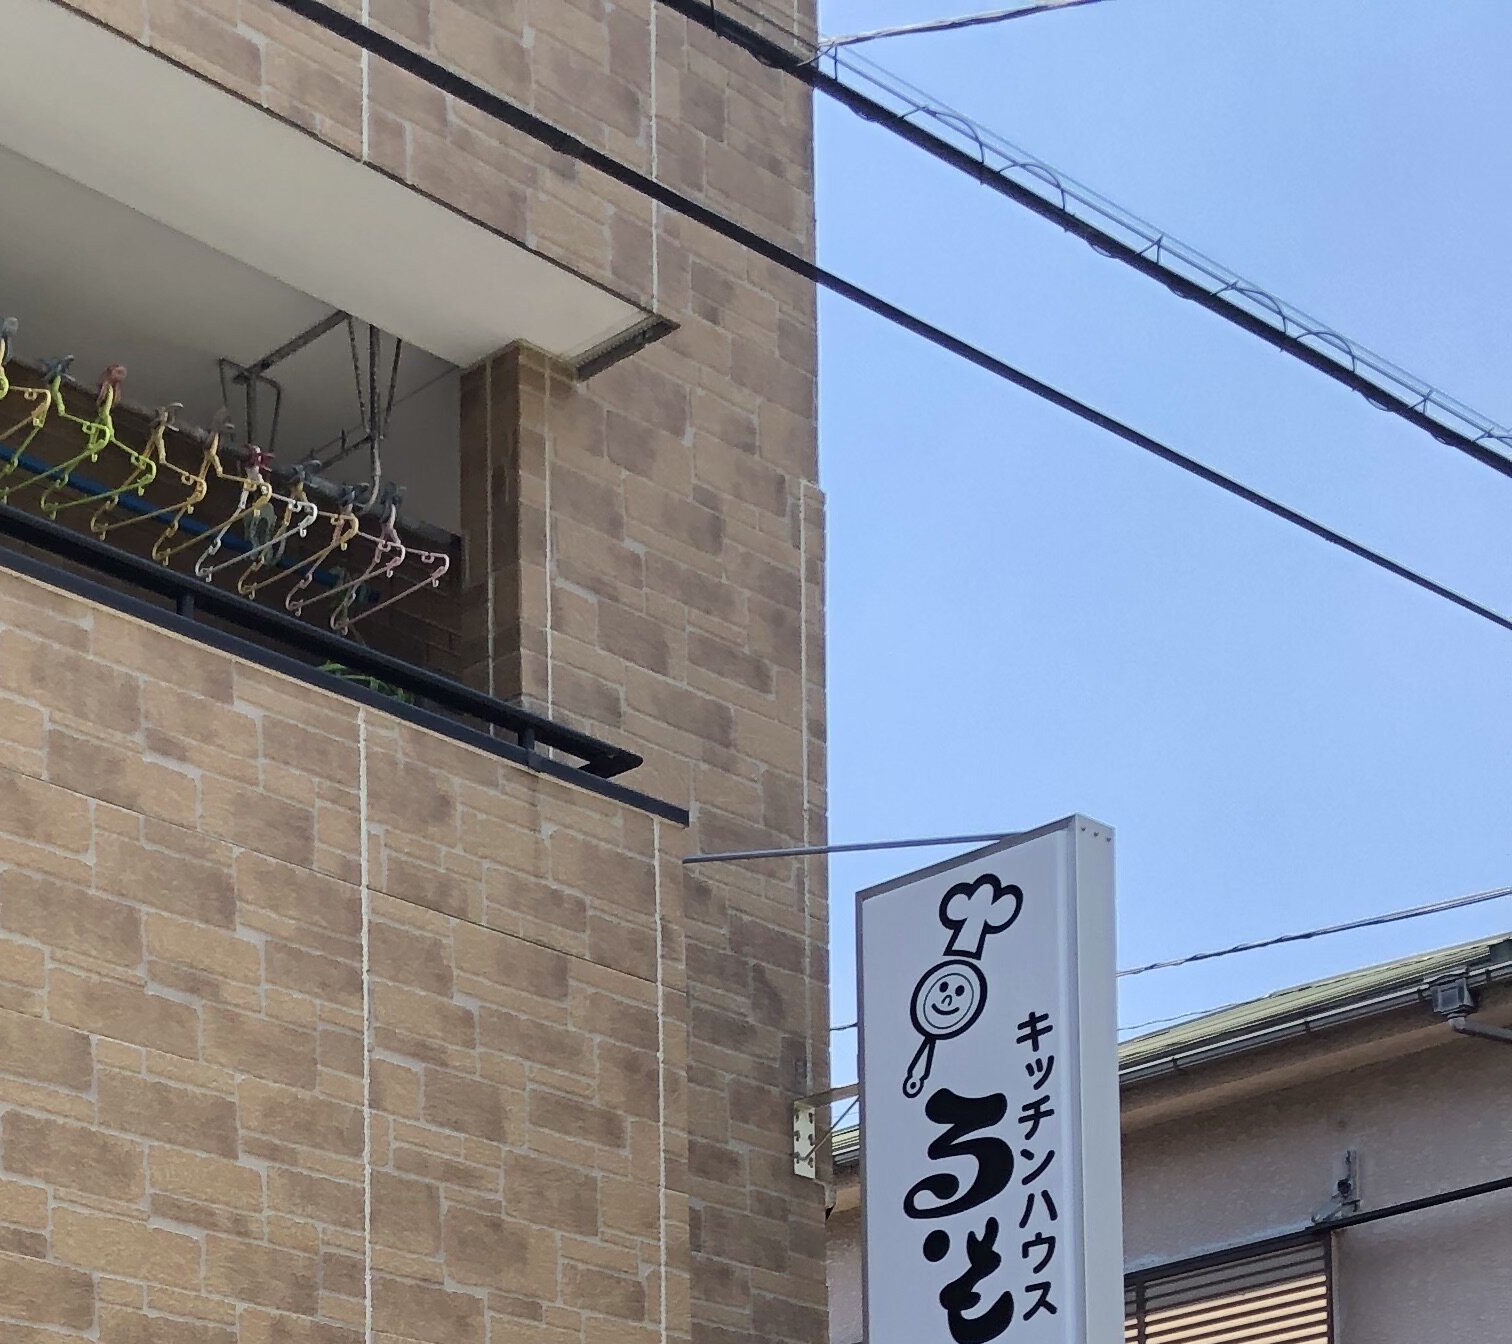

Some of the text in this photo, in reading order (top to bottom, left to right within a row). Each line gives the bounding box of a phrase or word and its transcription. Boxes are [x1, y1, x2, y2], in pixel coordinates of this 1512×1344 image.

[1014, 1010, 1059, 1322] キッチンハウス
